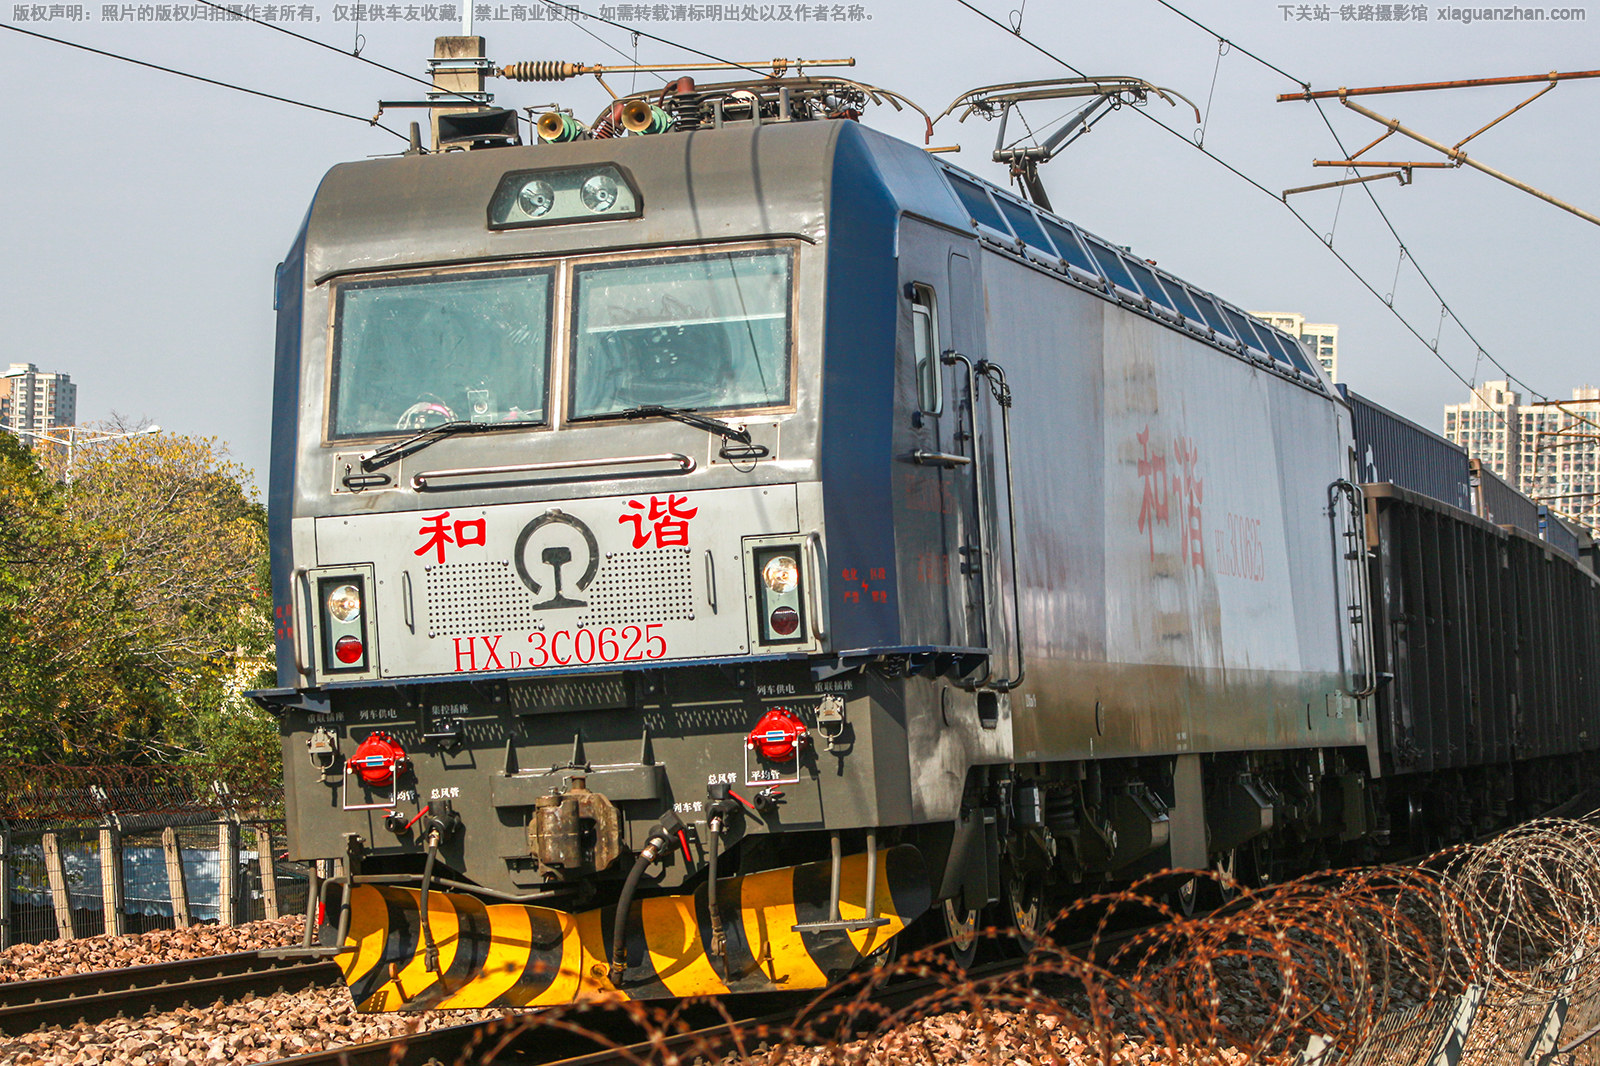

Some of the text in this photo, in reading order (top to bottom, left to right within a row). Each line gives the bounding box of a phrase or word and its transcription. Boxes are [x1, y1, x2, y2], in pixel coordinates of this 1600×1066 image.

[1136, 423, 1204, 569] 和谐
[414, 494, 698, 564] 和 谐
[756, 683, 796, 696] 列车供电
[359, 708, 398, 721] 列车供电
[707, 772, 738, 785] 总风管
[750, 769, 781, 781] 平均管
[430, 787, 460, 799] 总风管
[673, 801, 703, 813] 列车管
